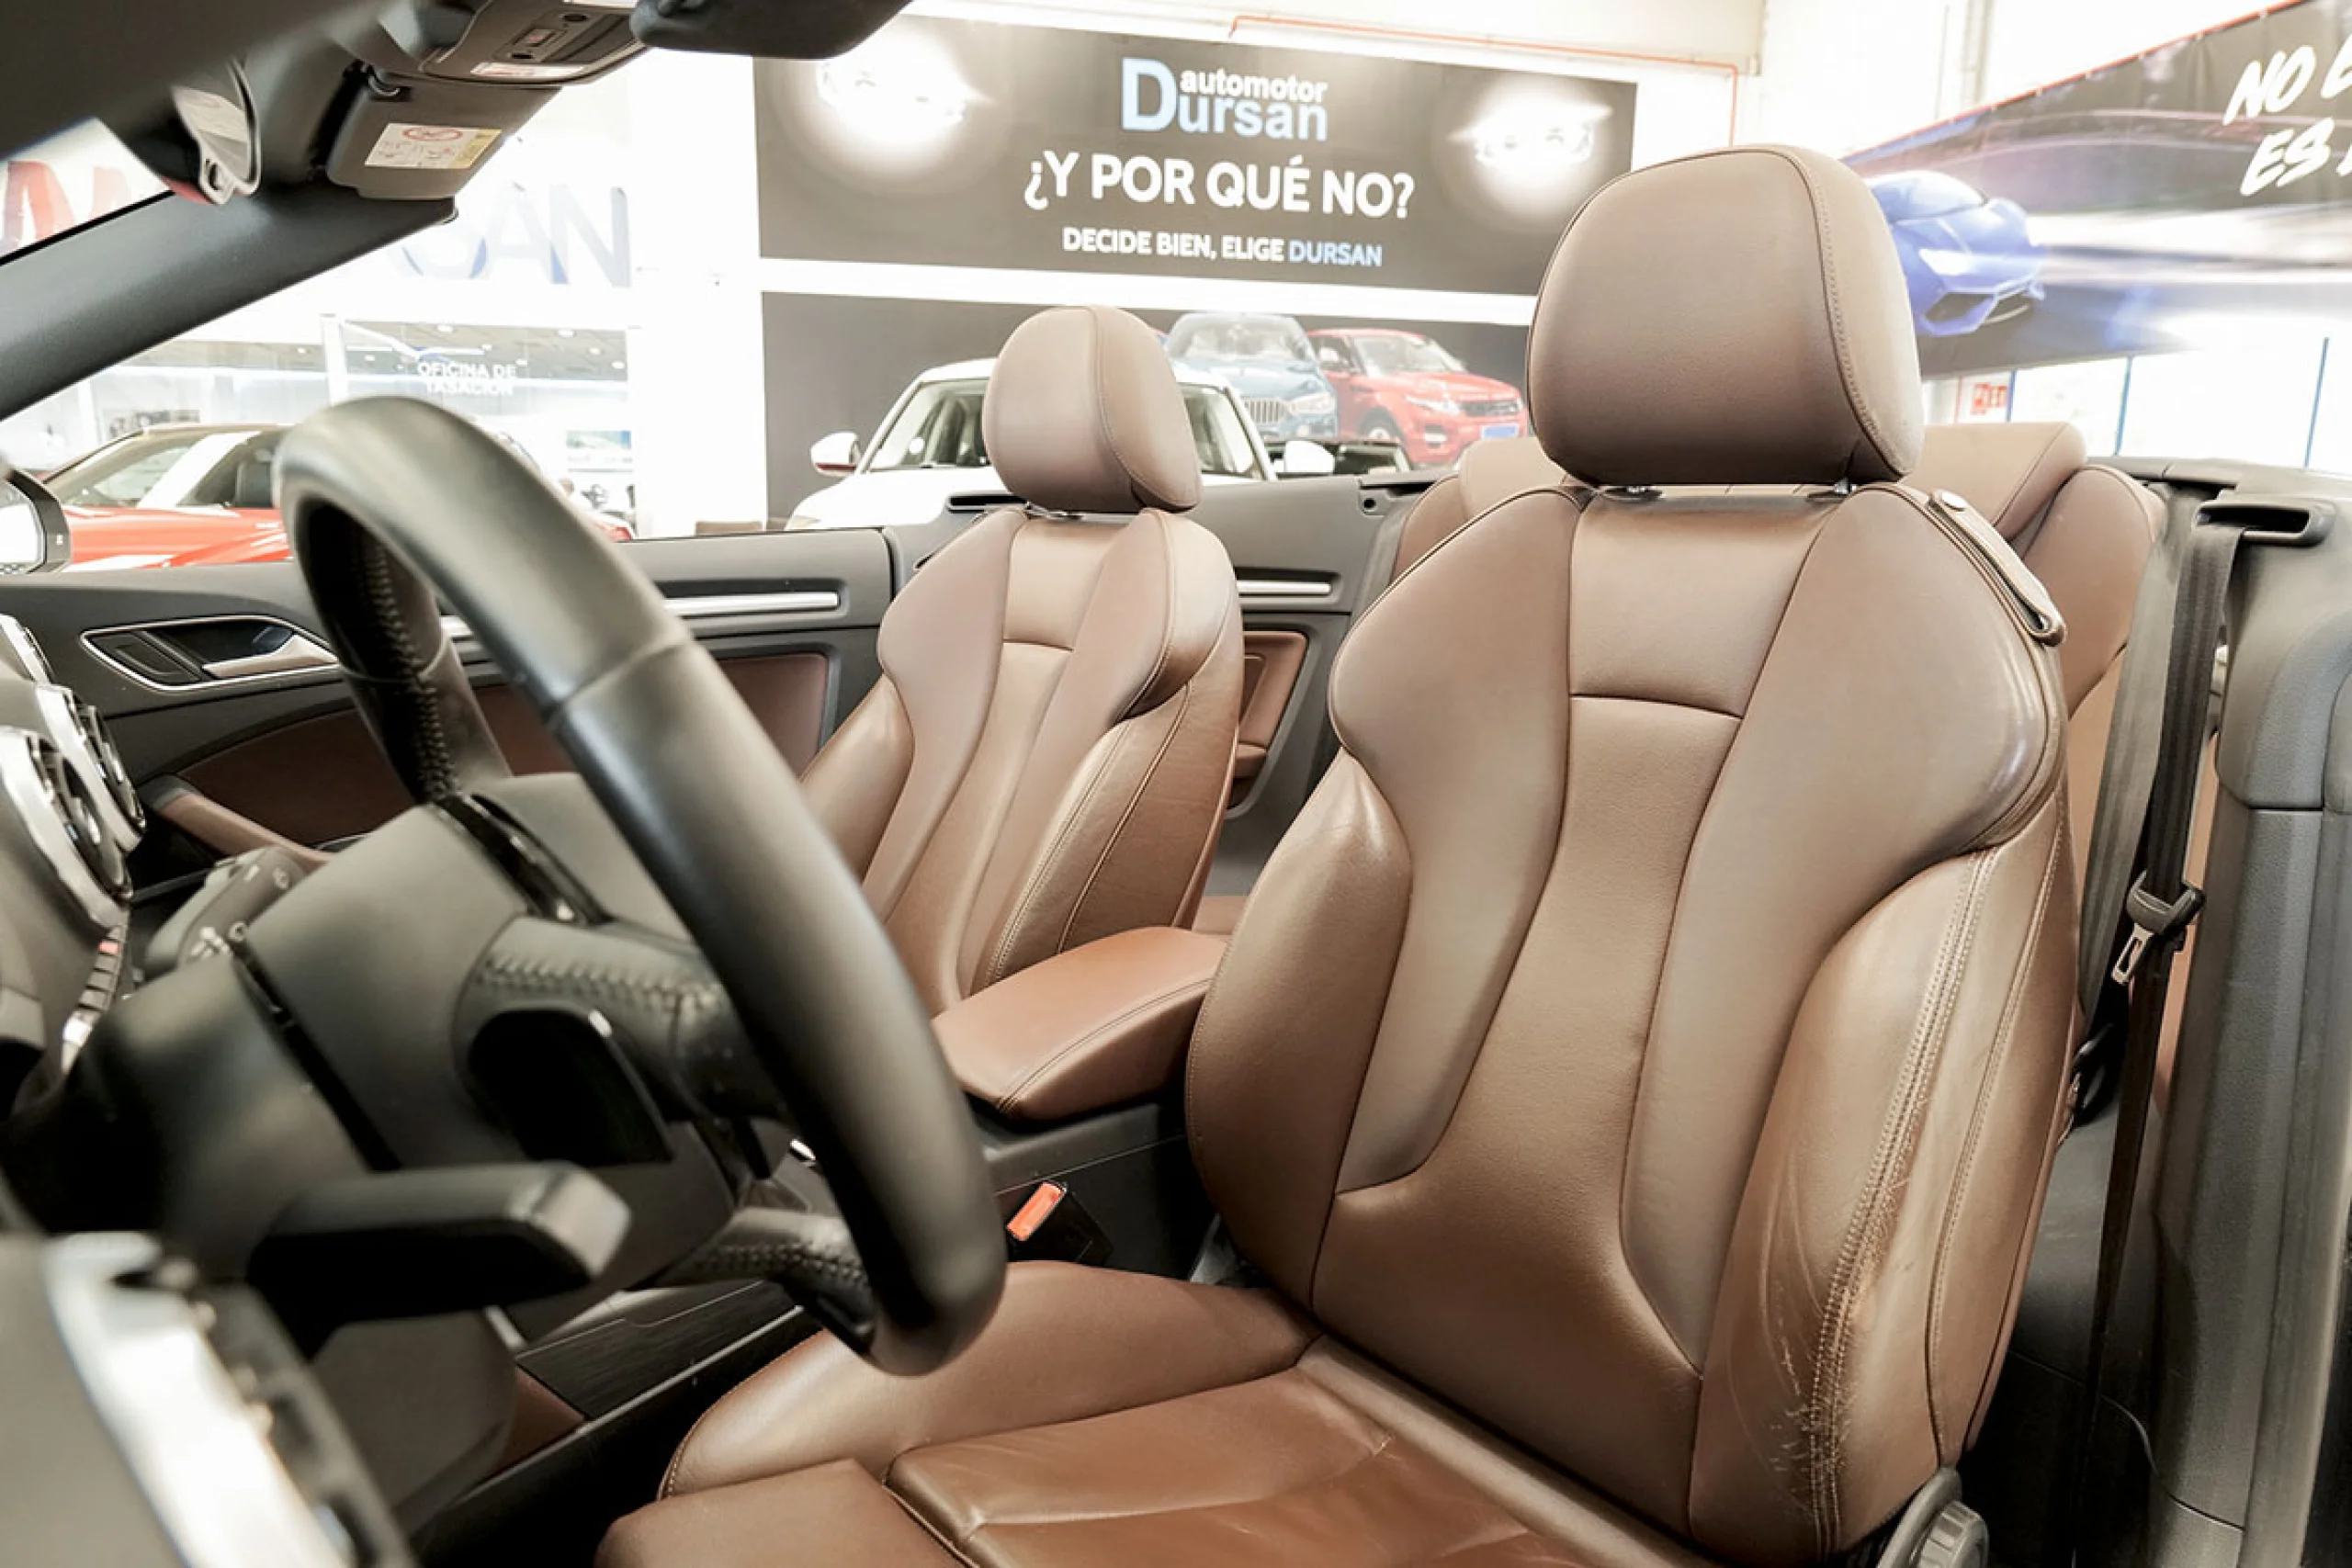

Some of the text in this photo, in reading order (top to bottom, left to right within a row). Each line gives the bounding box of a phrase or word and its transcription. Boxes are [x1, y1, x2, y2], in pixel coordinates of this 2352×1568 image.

[1121, 57, 1328, 141] Dursan
[1180, 69, 1328, 103] automotor
[2222, 44, 2316, 126] NO
[1023, 150, 1415, 219] ¿Y POR QUÉ NO?
[2240, 118, 2335, 197] ES
[1063, 227, 1383, 266] DECIDE BIEN, ELIGE DURSAN
[417, 361, 517, 379] OFICINA DE
